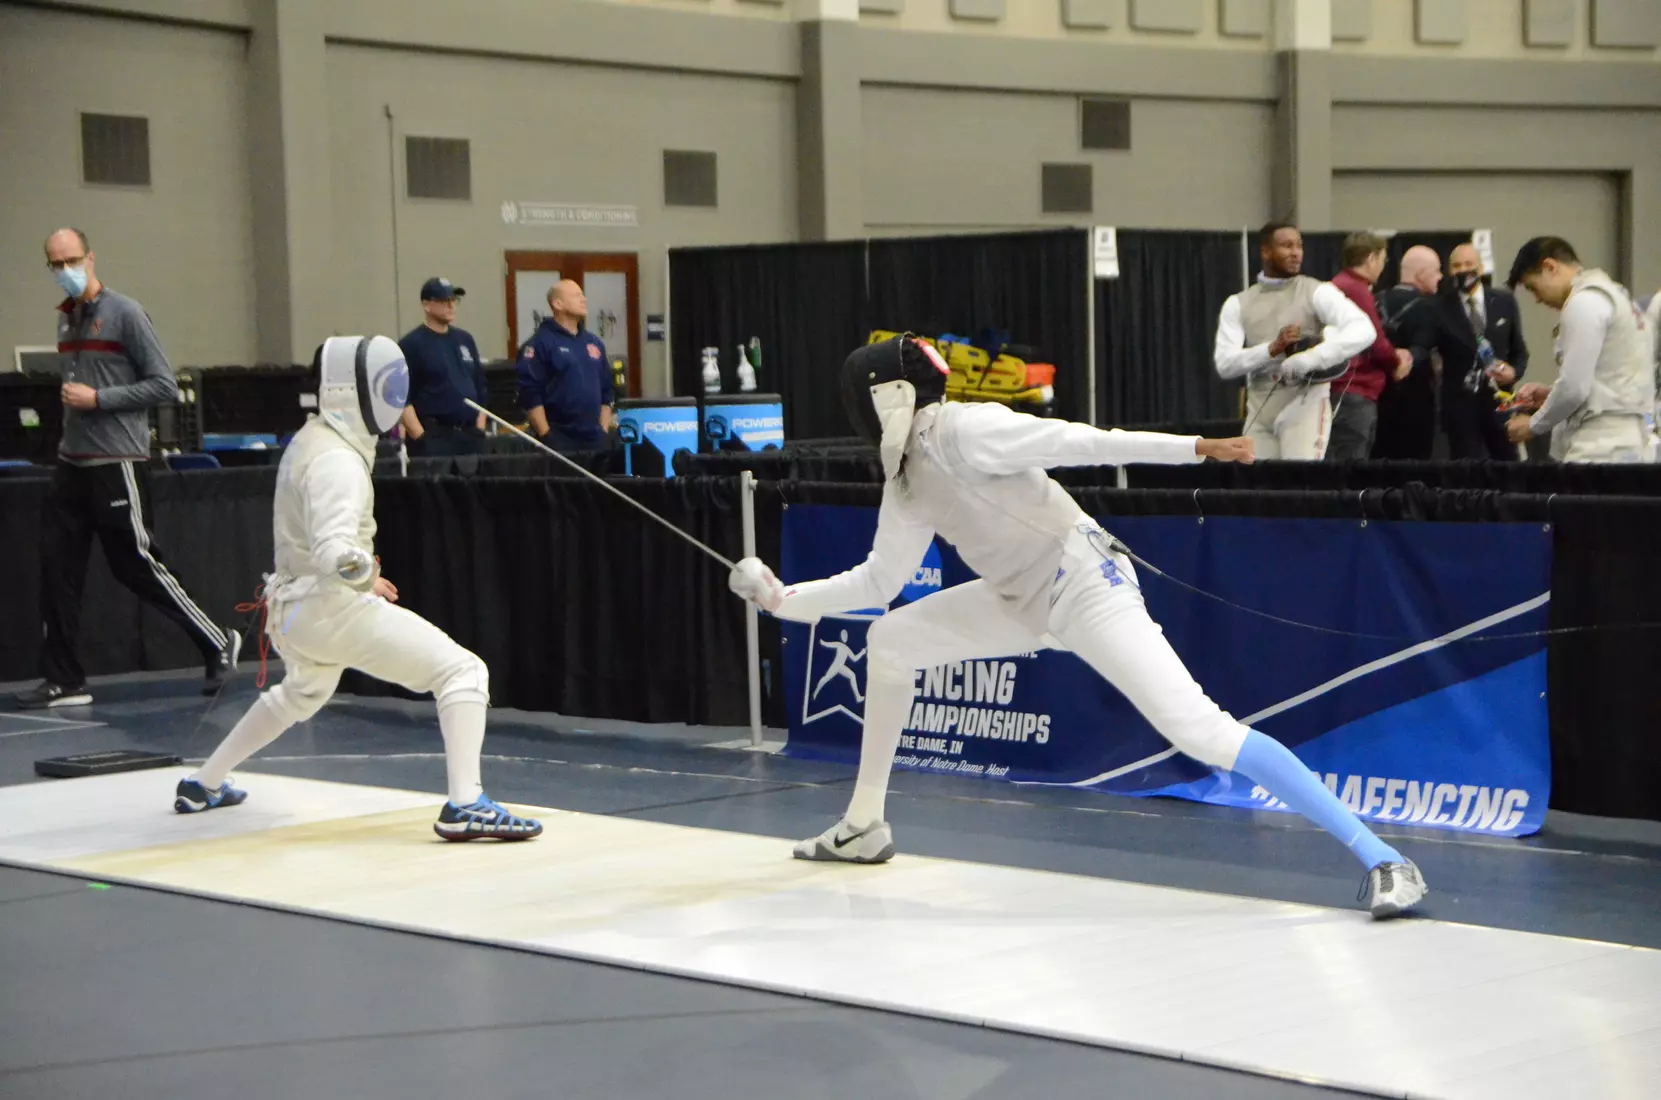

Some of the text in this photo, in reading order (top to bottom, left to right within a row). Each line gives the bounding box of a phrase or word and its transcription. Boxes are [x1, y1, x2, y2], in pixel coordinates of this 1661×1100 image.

[905, 566, 942, 587] CAA
[914, 659, 1017, 705] ENCING
[902, 702, 1051, 744] AMPIONSHIPS
[916, 735, 948, 754] DAME,
[949, 740, 964, 754] IN
[893, 754, 921, 767] versity
[919, 756, 934, 769] of
[930, 757, 958, 771] Notre
[984, 763, 1010, 777] Host
